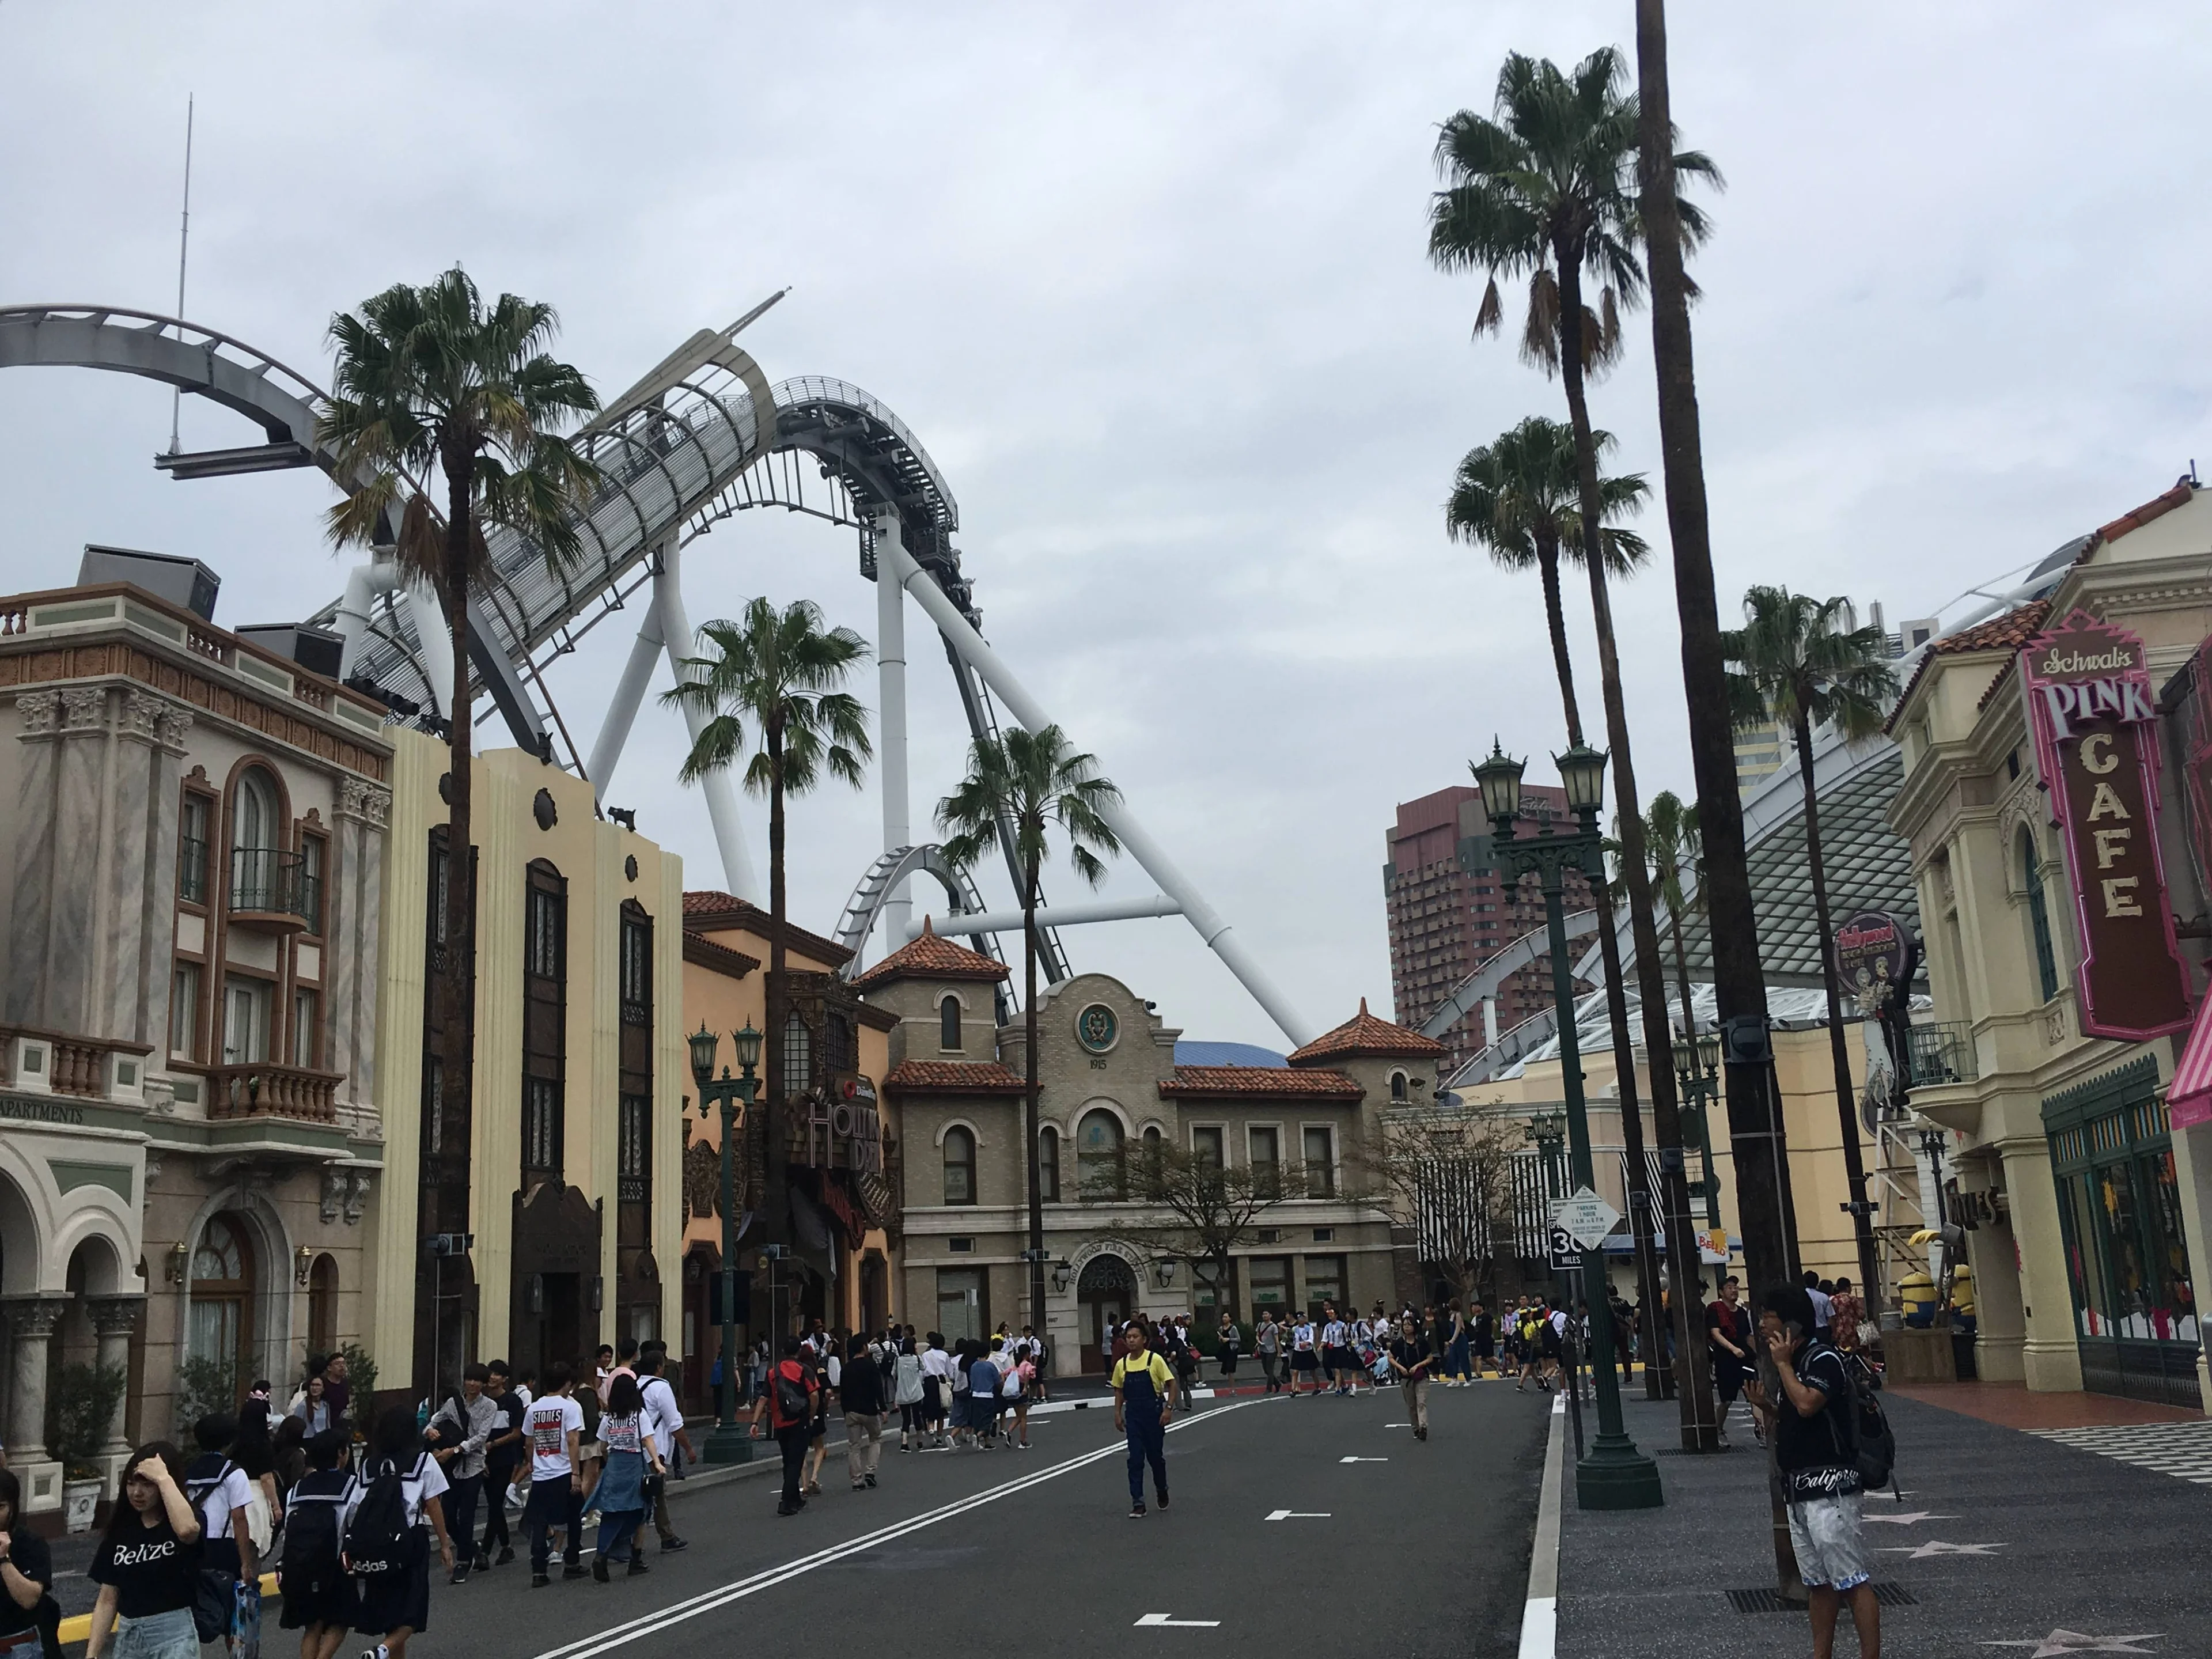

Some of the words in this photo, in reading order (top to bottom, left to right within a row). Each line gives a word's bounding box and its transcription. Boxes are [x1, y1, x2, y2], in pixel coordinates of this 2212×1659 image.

[2040, 677, 2156, 741] PINK
[2080, 733, 2143, 918] CAFE
[1090, 1059, 1107, 1070] 1915
[1699, 1236, 1725, 1256] BELLO
[1070, 1244, 1102, 1285] HOLLYWOOD
[1105, 1243, 1123, 1253] FIRE
[1562, 1256, 1581, 1264] MILES
[533, 1410, 562, 1423] STONES
[113, 1540, 175, 1565] Belize
